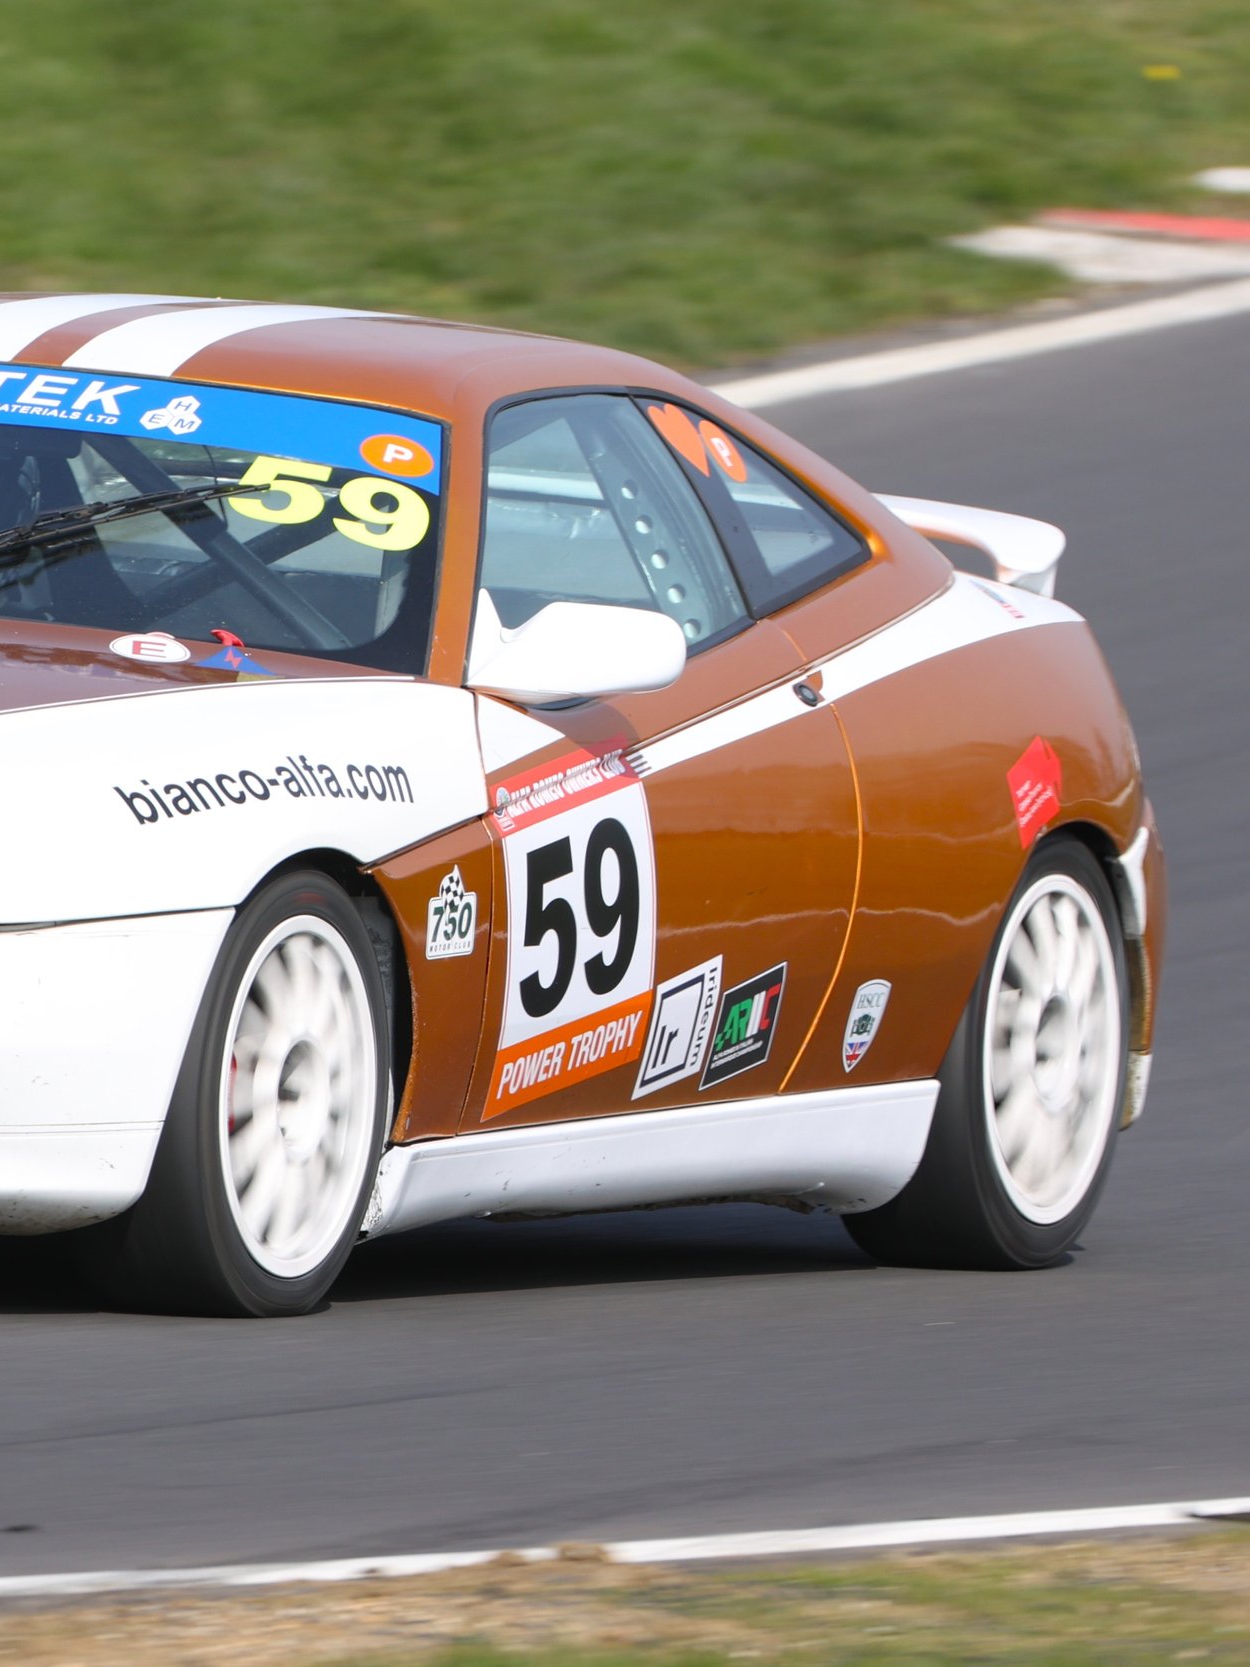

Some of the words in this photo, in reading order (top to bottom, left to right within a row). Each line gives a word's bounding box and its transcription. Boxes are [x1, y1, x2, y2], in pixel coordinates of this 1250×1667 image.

[85, 412, 119, 426] LTD
[381, 443, 413, 468] P
[227, 455, 431, 552] 59
[131, 640, 167, 659] E
[112, 754, 415, 825] bianco-alfa.com
[431, 902, 473, 943] 750
[519, 817, 641, 1019] 59
[430, 943, 451, 953] MOTOR
[454, 941, 471, 950] CLUB
[690, 966, 718, 1067] Irideum
[496, 1041, 567, 1101] POWER
[567, 1010, 644, 1071] TROPHY
